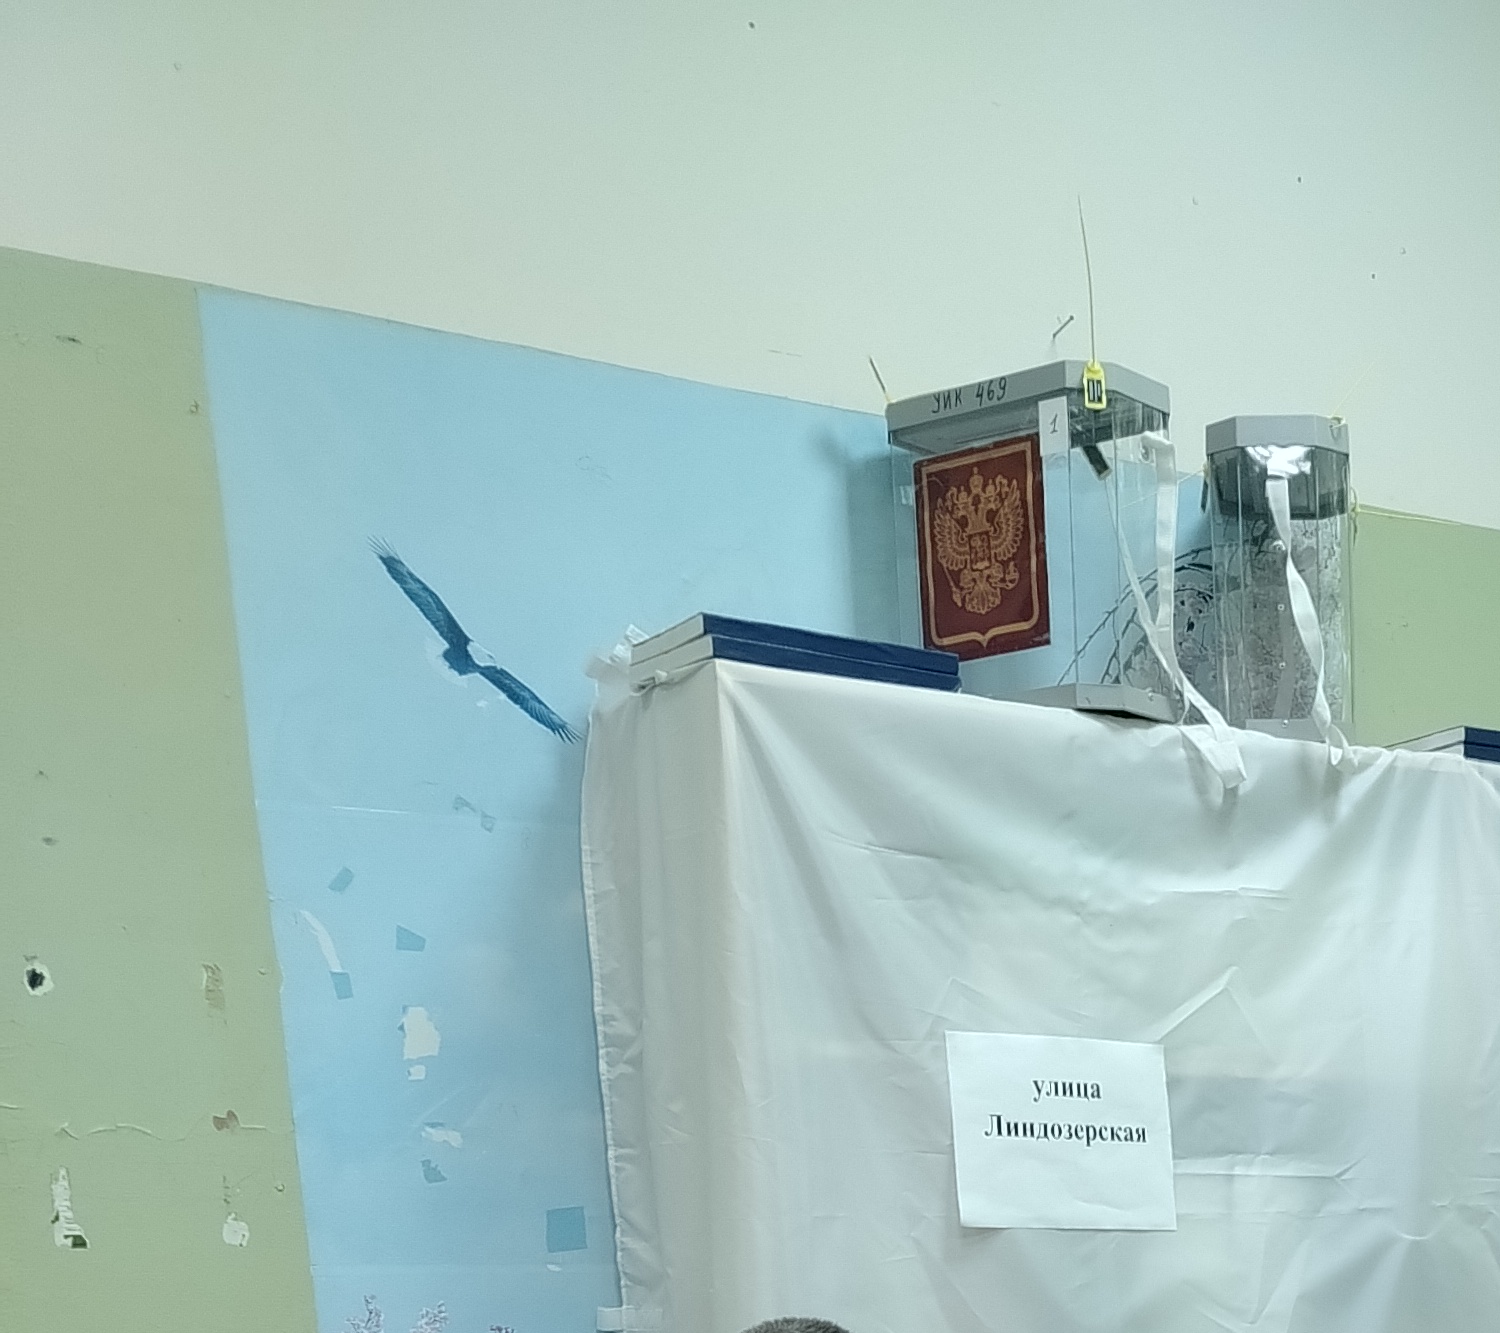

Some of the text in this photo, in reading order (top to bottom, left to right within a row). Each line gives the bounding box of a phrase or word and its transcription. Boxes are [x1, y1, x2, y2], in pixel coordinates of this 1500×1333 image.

[931, 377, 1007, 414] УИК 469
[1049, 413, 1058, 433] 1
[1032, 1079, 1101, 1102] улица
[984, 1114, 1147, 1147] Линдозерская
